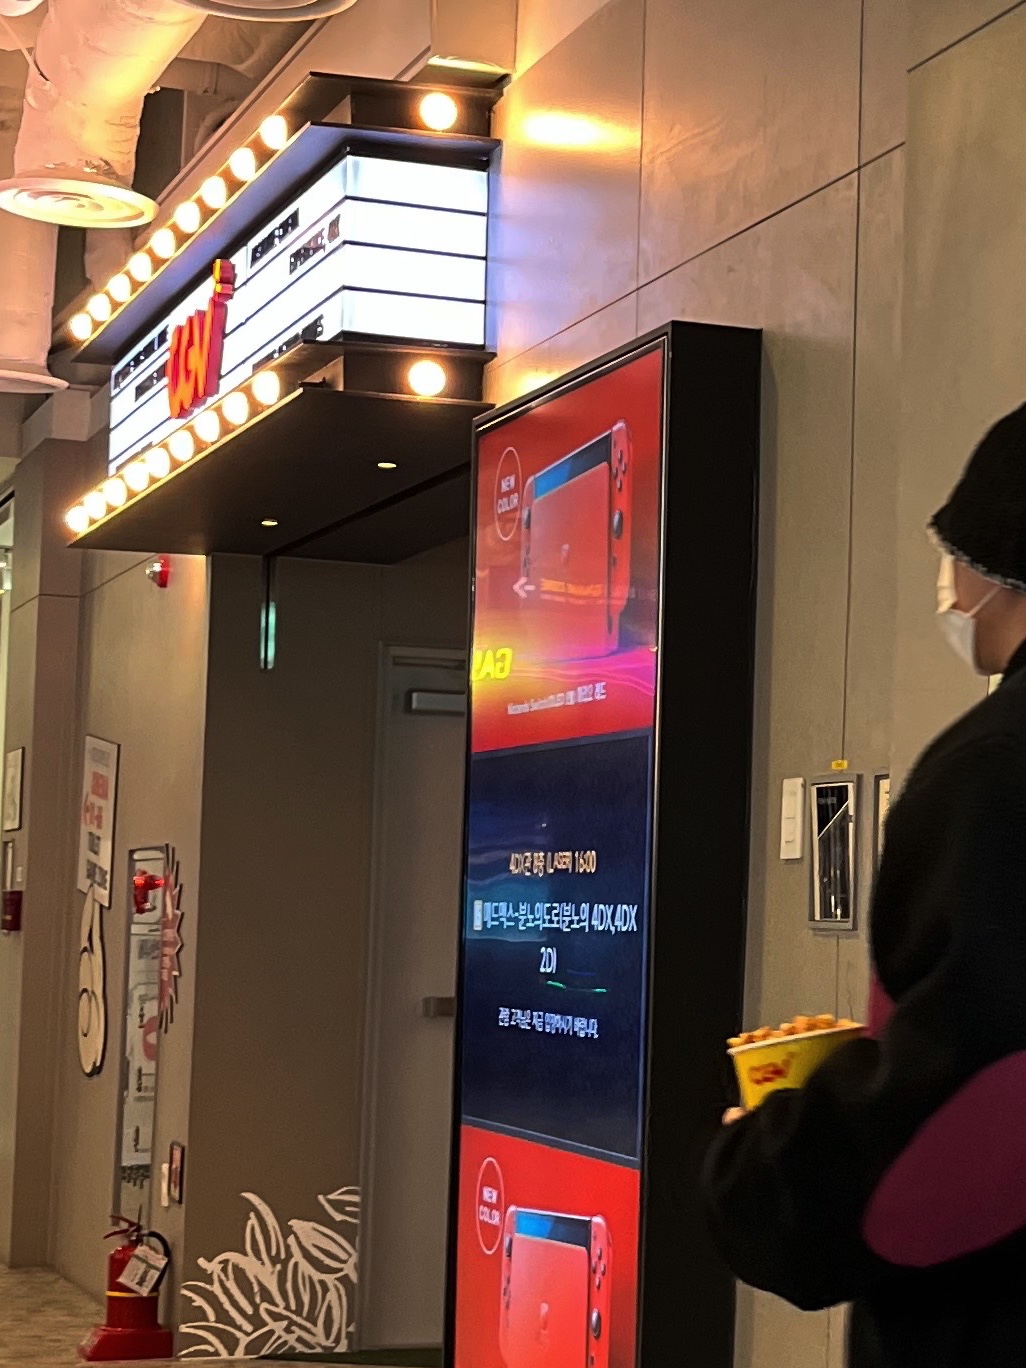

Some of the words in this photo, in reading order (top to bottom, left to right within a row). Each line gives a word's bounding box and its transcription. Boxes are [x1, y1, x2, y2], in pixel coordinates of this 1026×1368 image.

[501, 474, 516, 493] NEW
[498, 492, 519, 514] COLOR
[592, 903, 638, 935] 4DX,4DX
[482, 1186, 498, 1204] NEW
[479, 1204, 501, 1226] COLOR
